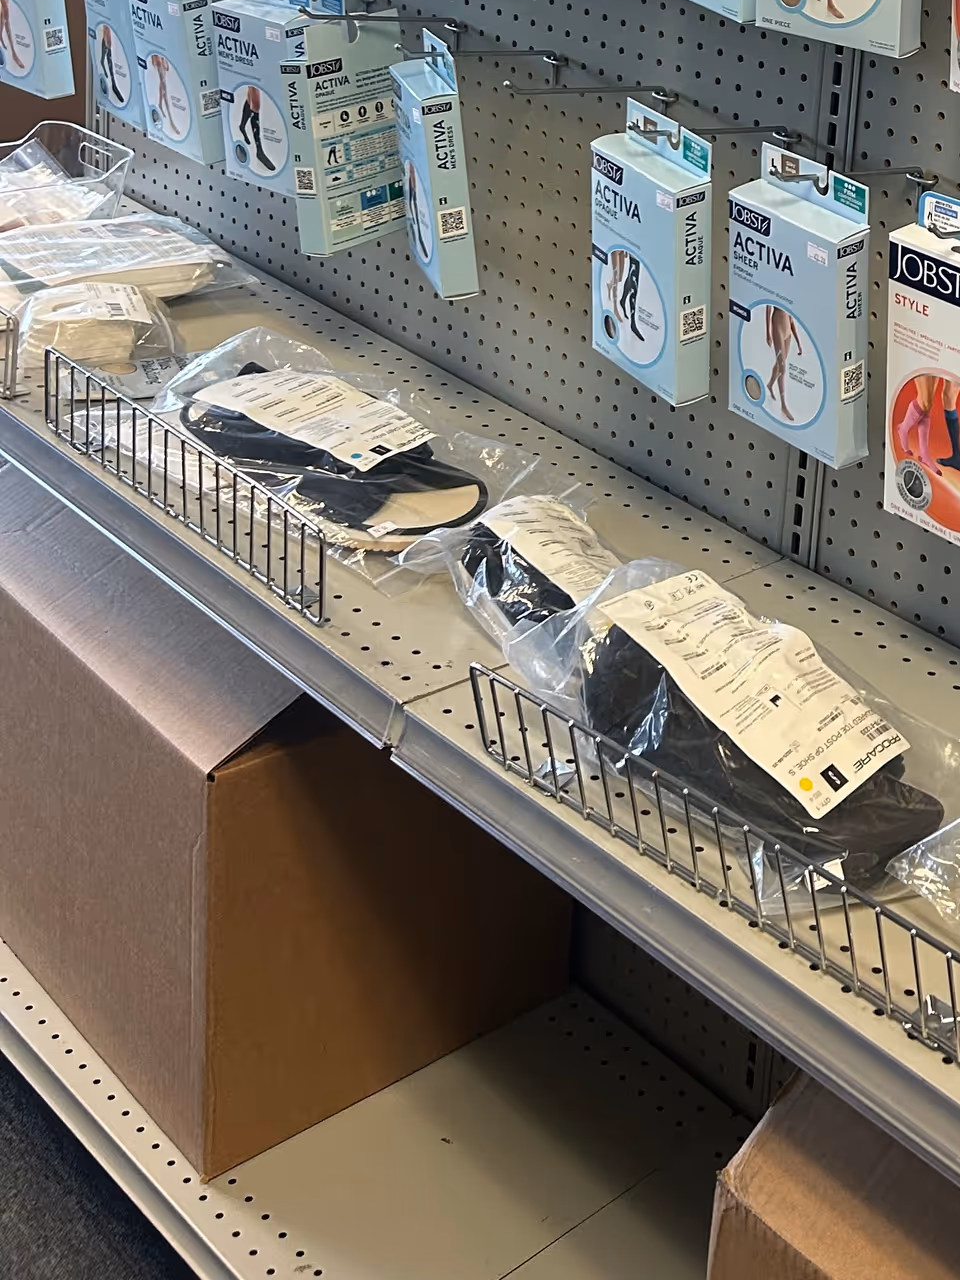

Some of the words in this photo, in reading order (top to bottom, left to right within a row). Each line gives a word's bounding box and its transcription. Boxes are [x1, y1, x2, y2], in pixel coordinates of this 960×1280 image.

[132, 4, 163, 30] ACTIVA
[193, 14, 208, 57] ACTIVA
[218, 34, 259, 59] ACTIVA
[235, 55, 254, 67] DRESS
[315, 75, 351, 92] ACTIVA
[289, 81, 301, 129] ACTIVA
[434, 120, 450, 170] ACTIVA
[448, 126, 456, 148] DRESS
[595, 179, 641, 224] ACTIVA
[595, 198, 618, 220] OPAQUE
[732, 202, 763, 229] JOBST
[685, 211, 697, 266] ACTIVA
[733, 231, 794, 277] ACTIVA
[733, 250, 759, 271] SHEER
[846, 261, 857, 319] ACTIVA
[895, 293, 929, 317] STYLE
[852, 733, 901, 774] PROCARE
